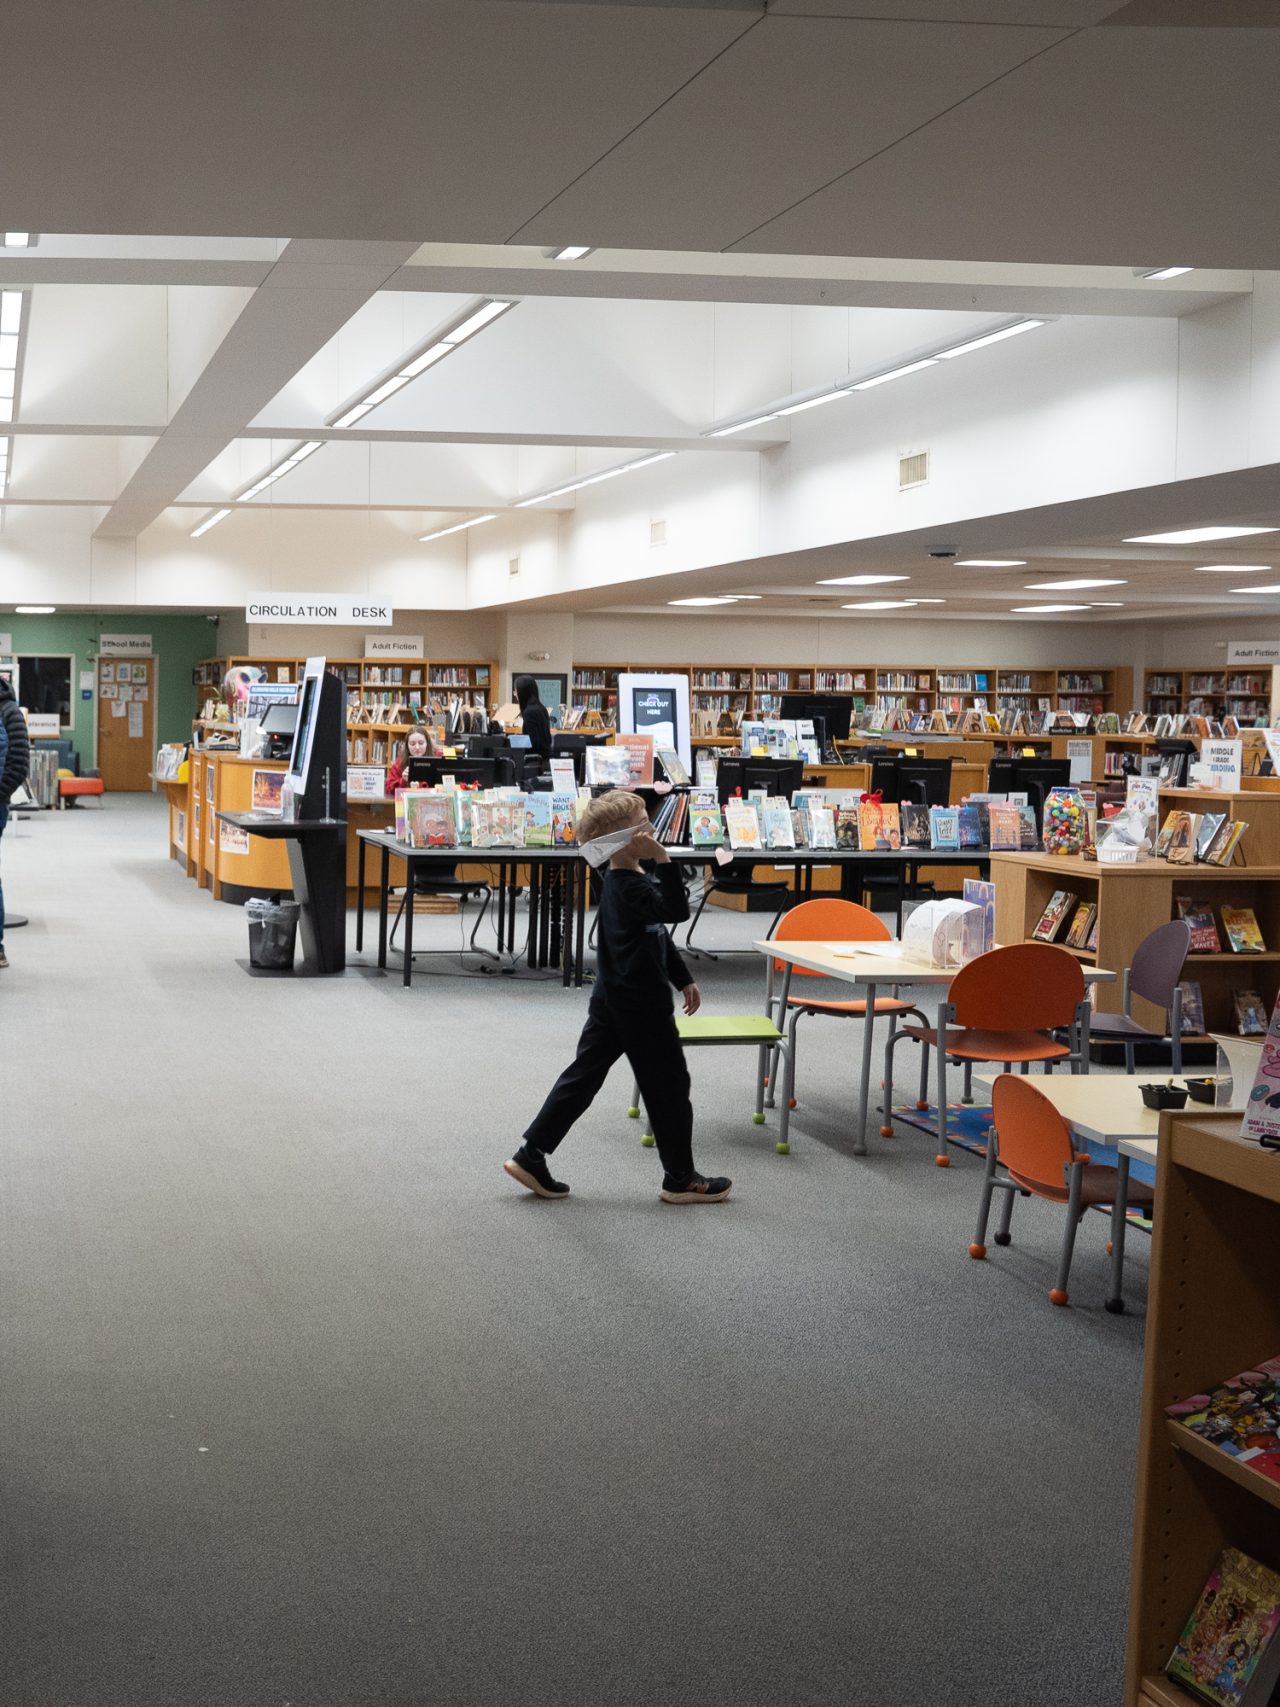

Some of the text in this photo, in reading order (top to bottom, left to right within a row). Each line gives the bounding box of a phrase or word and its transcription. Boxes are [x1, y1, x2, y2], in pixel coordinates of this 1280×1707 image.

[249, 605, 387, 618] CIRCULATION DESK
[372, 642, 417, 650] Adult Fiction
[1210, 747, 1234, 756] MIDDLE
